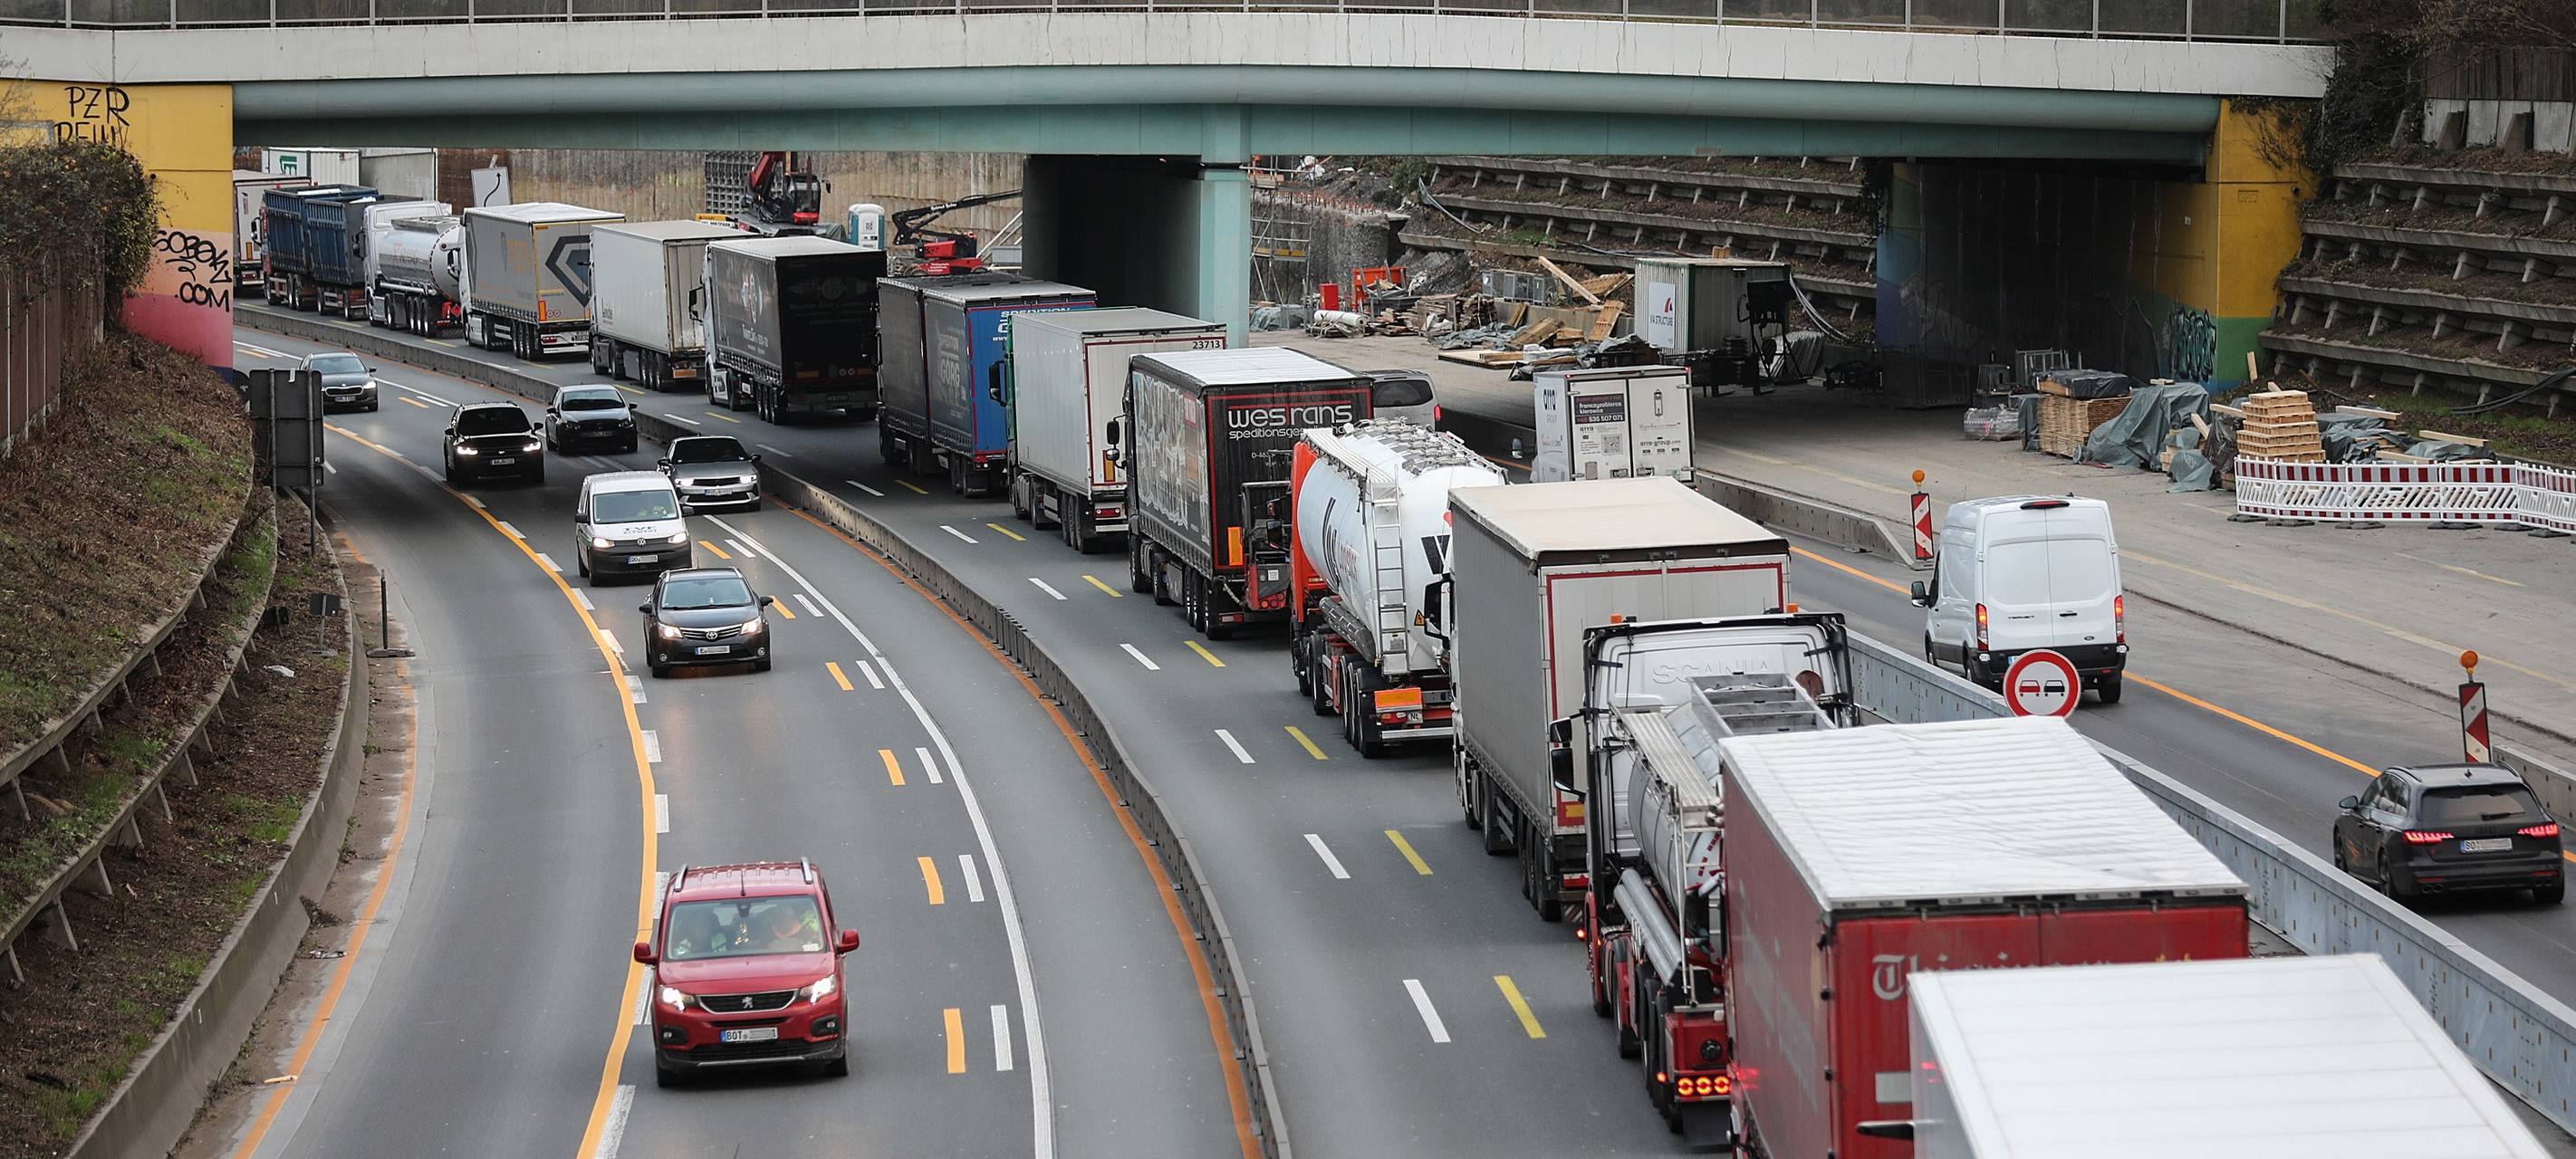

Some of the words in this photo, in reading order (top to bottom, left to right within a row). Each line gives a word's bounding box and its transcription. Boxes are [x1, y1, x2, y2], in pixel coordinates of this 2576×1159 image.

[64, 86, 130, 127] PZR
[1192, 340, 1221, 350] 23713
[1410, 712, 1420, 720] NL
[726, 1030, 743, 1040] BOT
